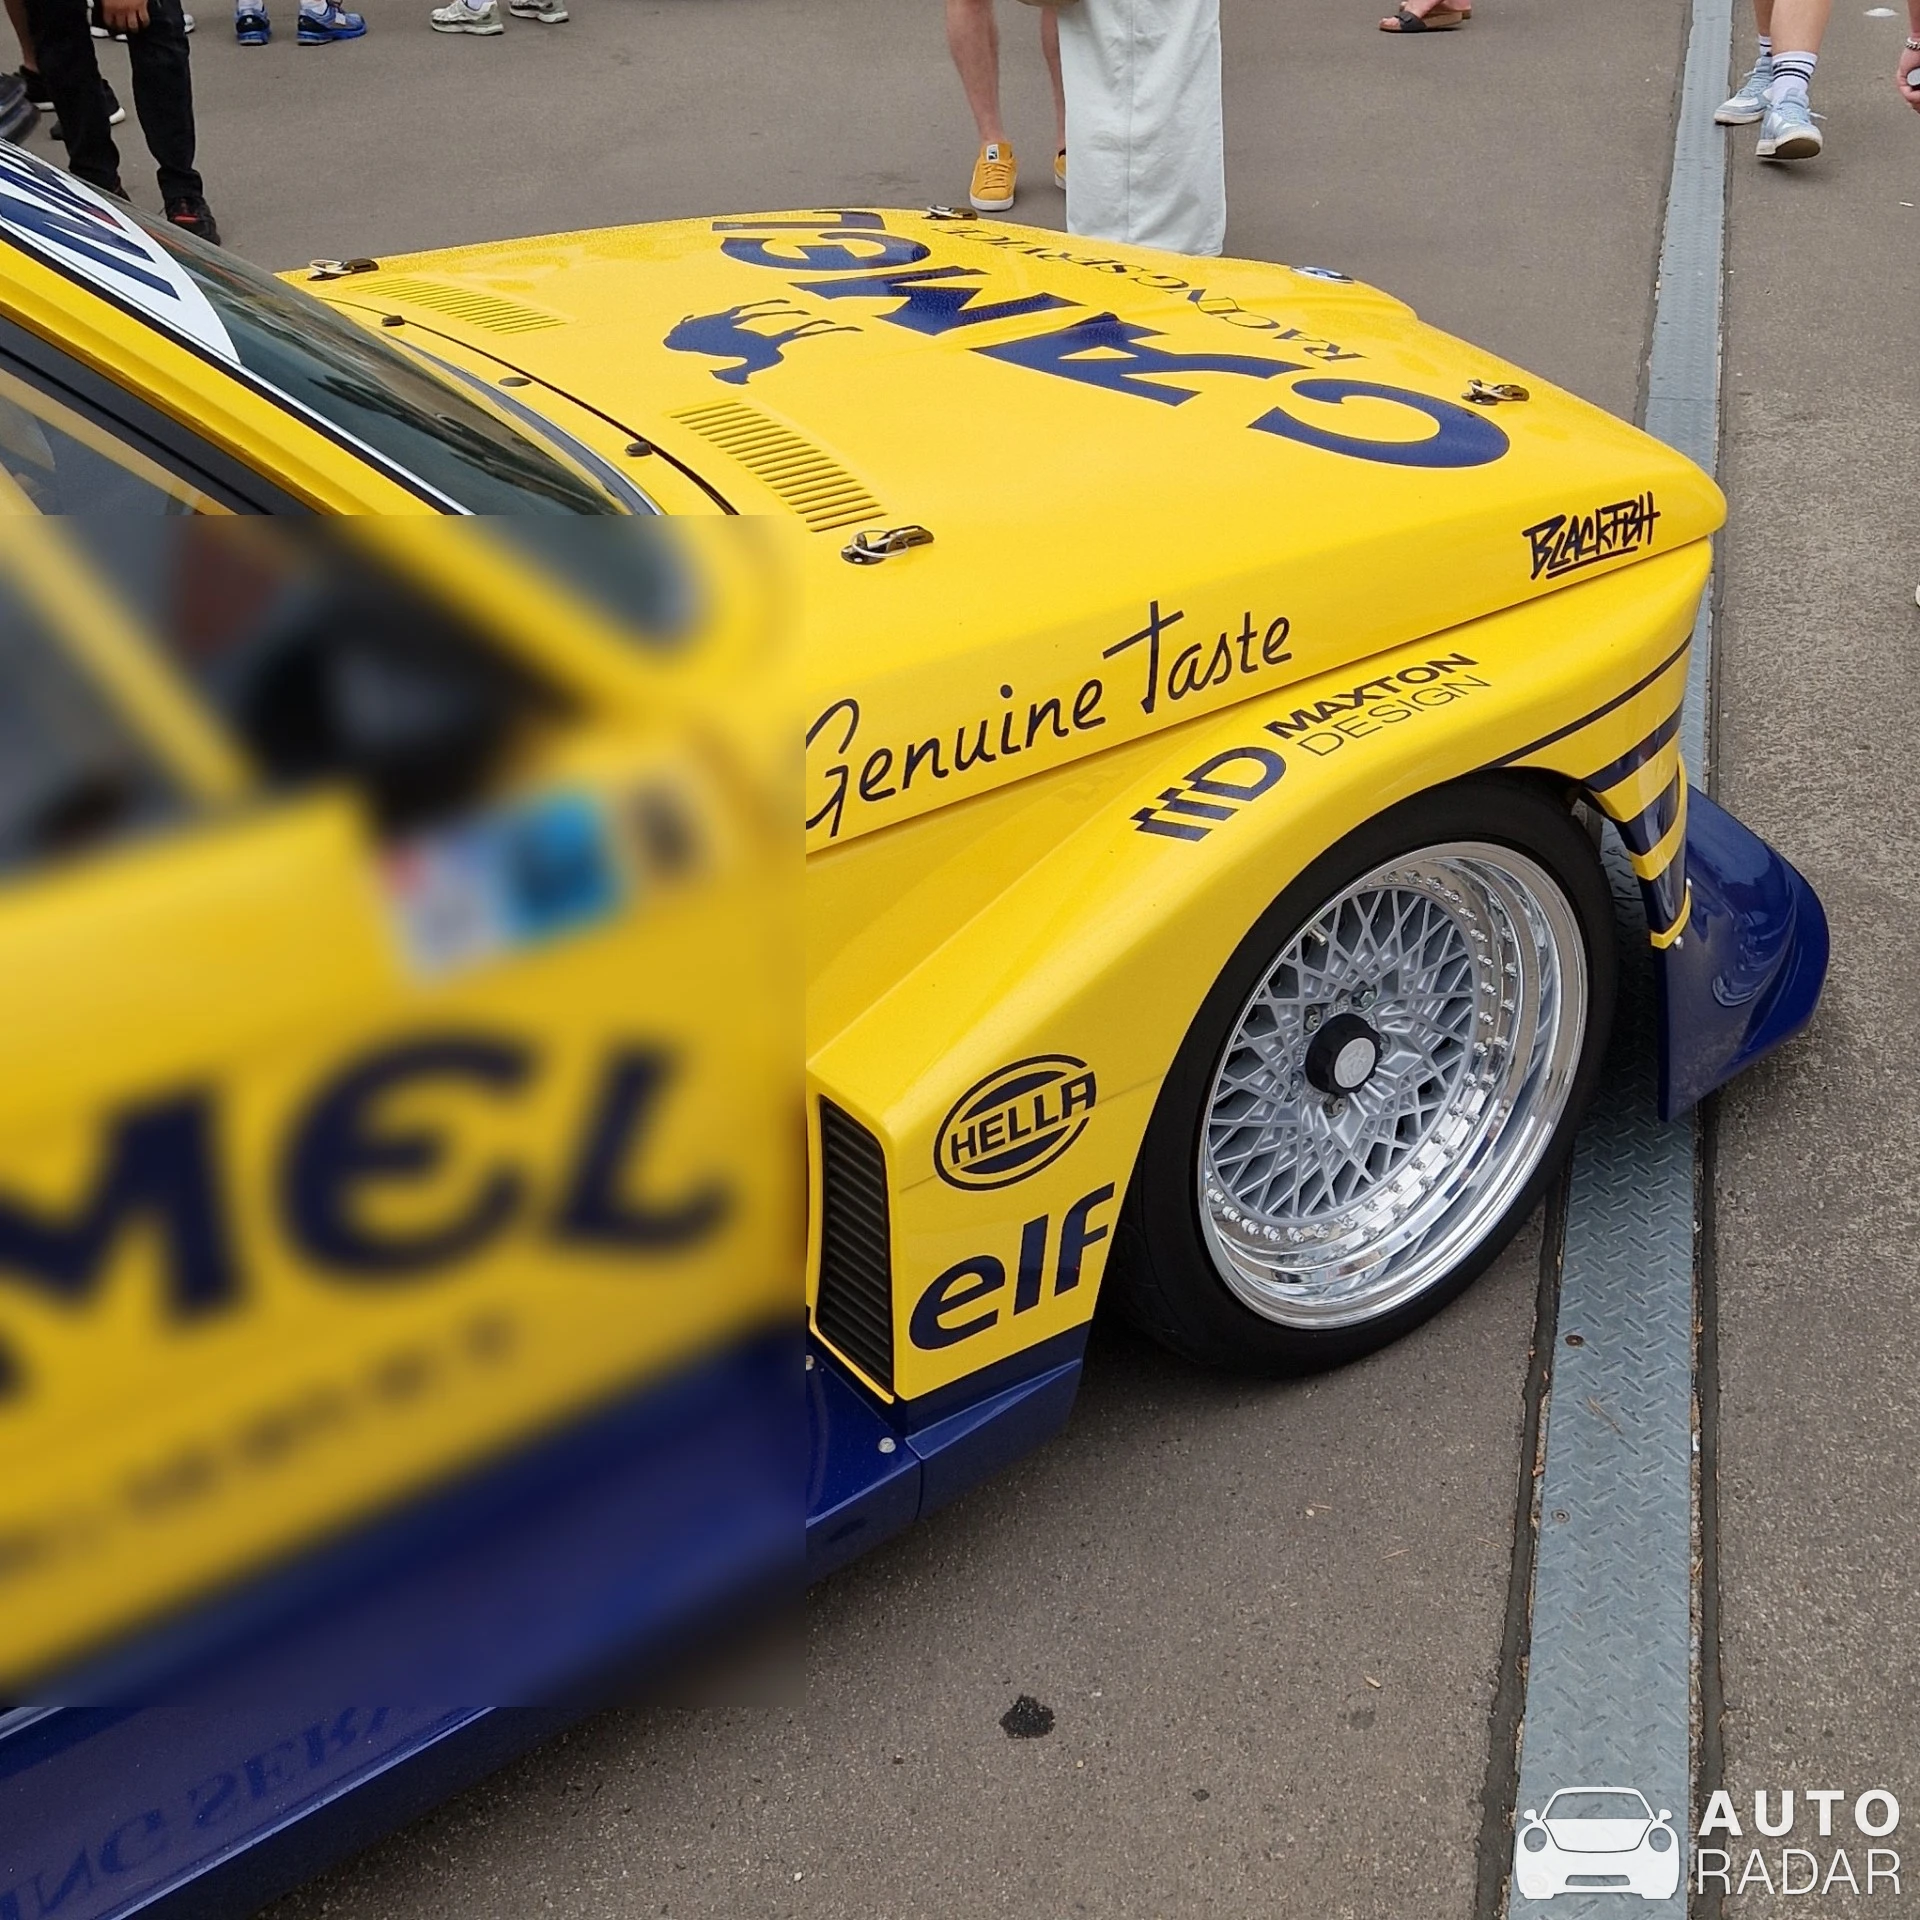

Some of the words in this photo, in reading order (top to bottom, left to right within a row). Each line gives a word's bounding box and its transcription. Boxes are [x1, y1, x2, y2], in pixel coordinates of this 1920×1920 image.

[931, 226, 1152, 274] SERVICE
[1130, 274, 1370, 362] RACING
[806, 678, 1106, 838] Genuine
[1102, 600, 1293, 715] Taste
[1263, 652, 1480, 740] MAXTON
[1297, 674, 1492, 757] DESIGN
[950, 1071, 1098, 1165] HELLA
[909, 1182, 1116, 1351] elf
